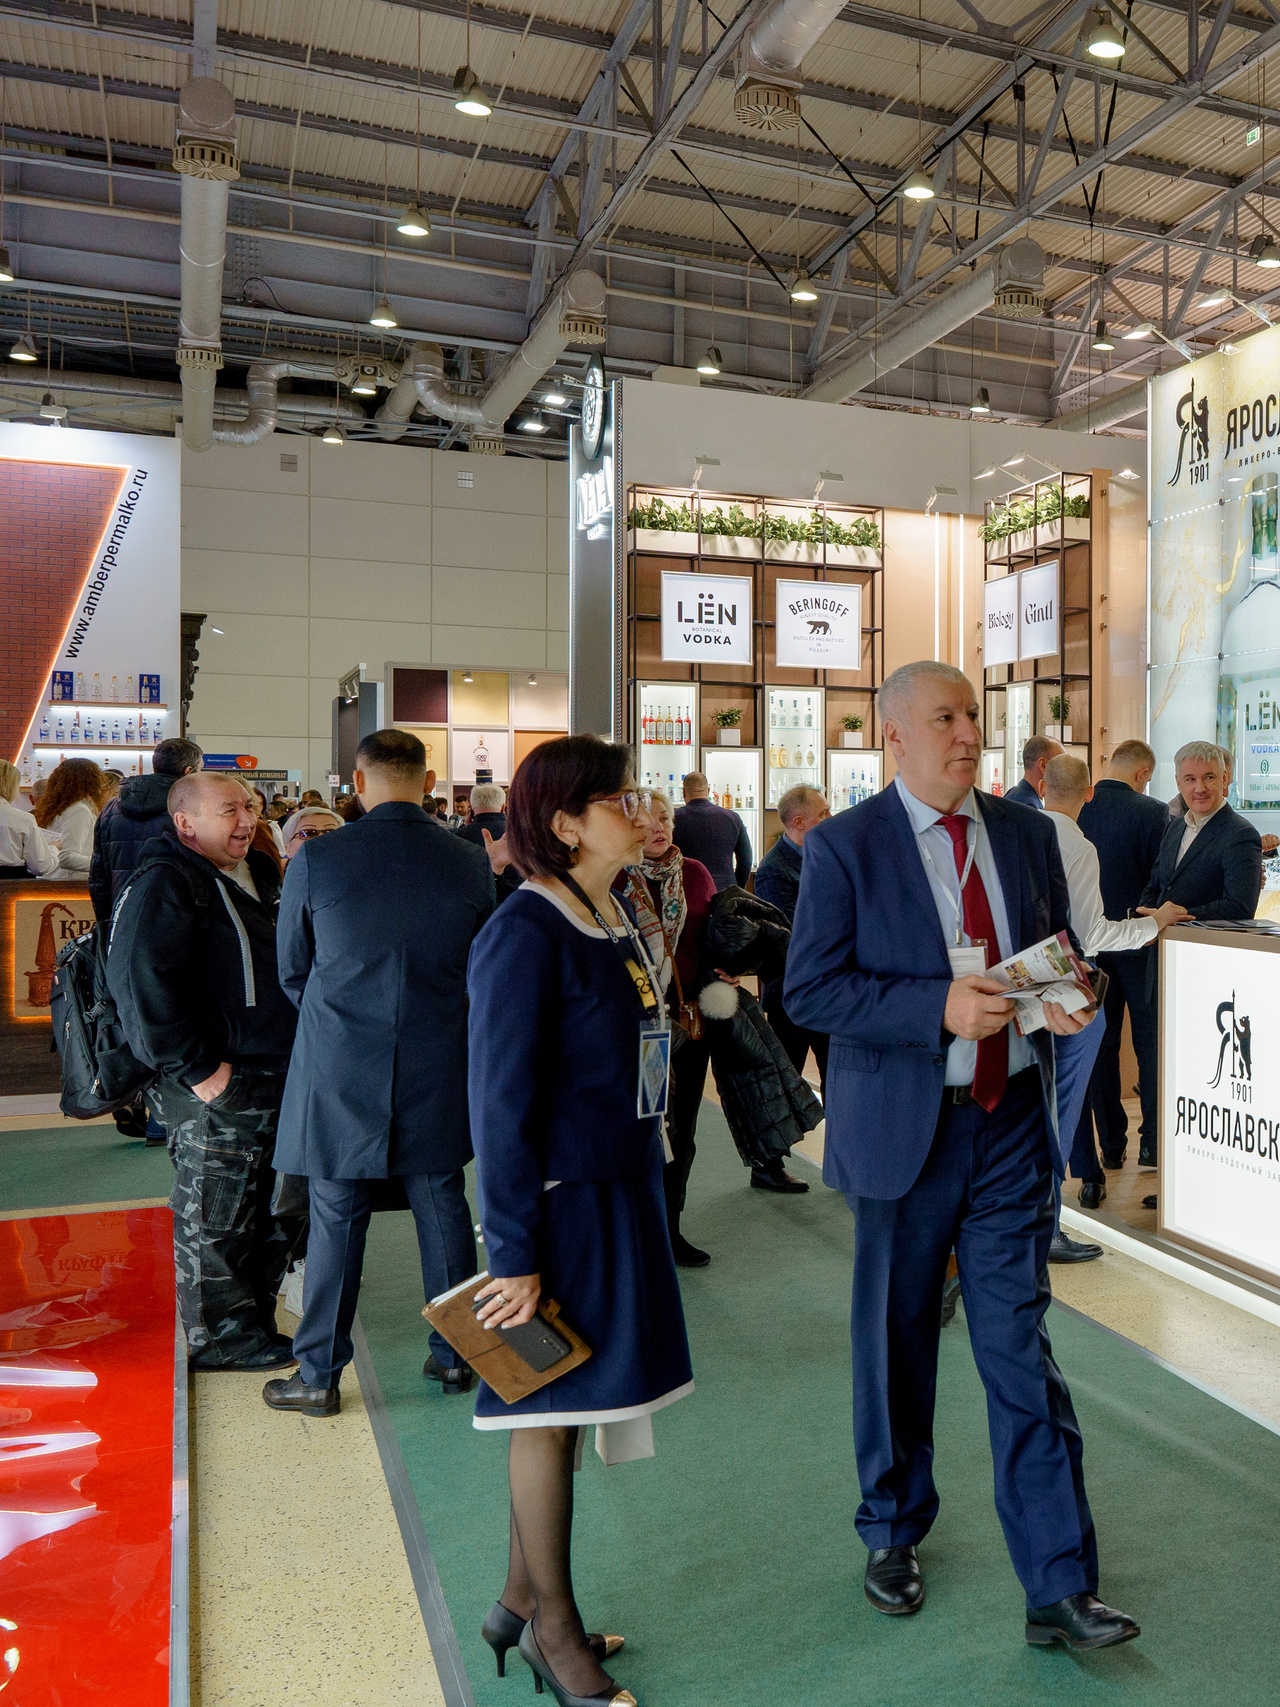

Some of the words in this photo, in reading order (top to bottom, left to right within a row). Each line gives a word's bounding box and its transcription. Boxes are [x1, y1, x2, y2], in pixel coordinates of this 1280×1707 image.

[1189, 462, 1210, 485] 1901
[65, 469, 149, 659] www.amberpermalko.ru
[677, 593, 737, 626] LËN
[788, 597, 849, 617] BERINGOFF
[817, 612, 837, 621] QUALITY
[683, 634, 732, 645] VODKA
[1251, 743, 1280, 754] VODKA
[1230, 1081, 1252, 1104] 1901
[1187, 1145, 1263, 1176] ЛИКЕРО-ВОДОЧНЫЙ
